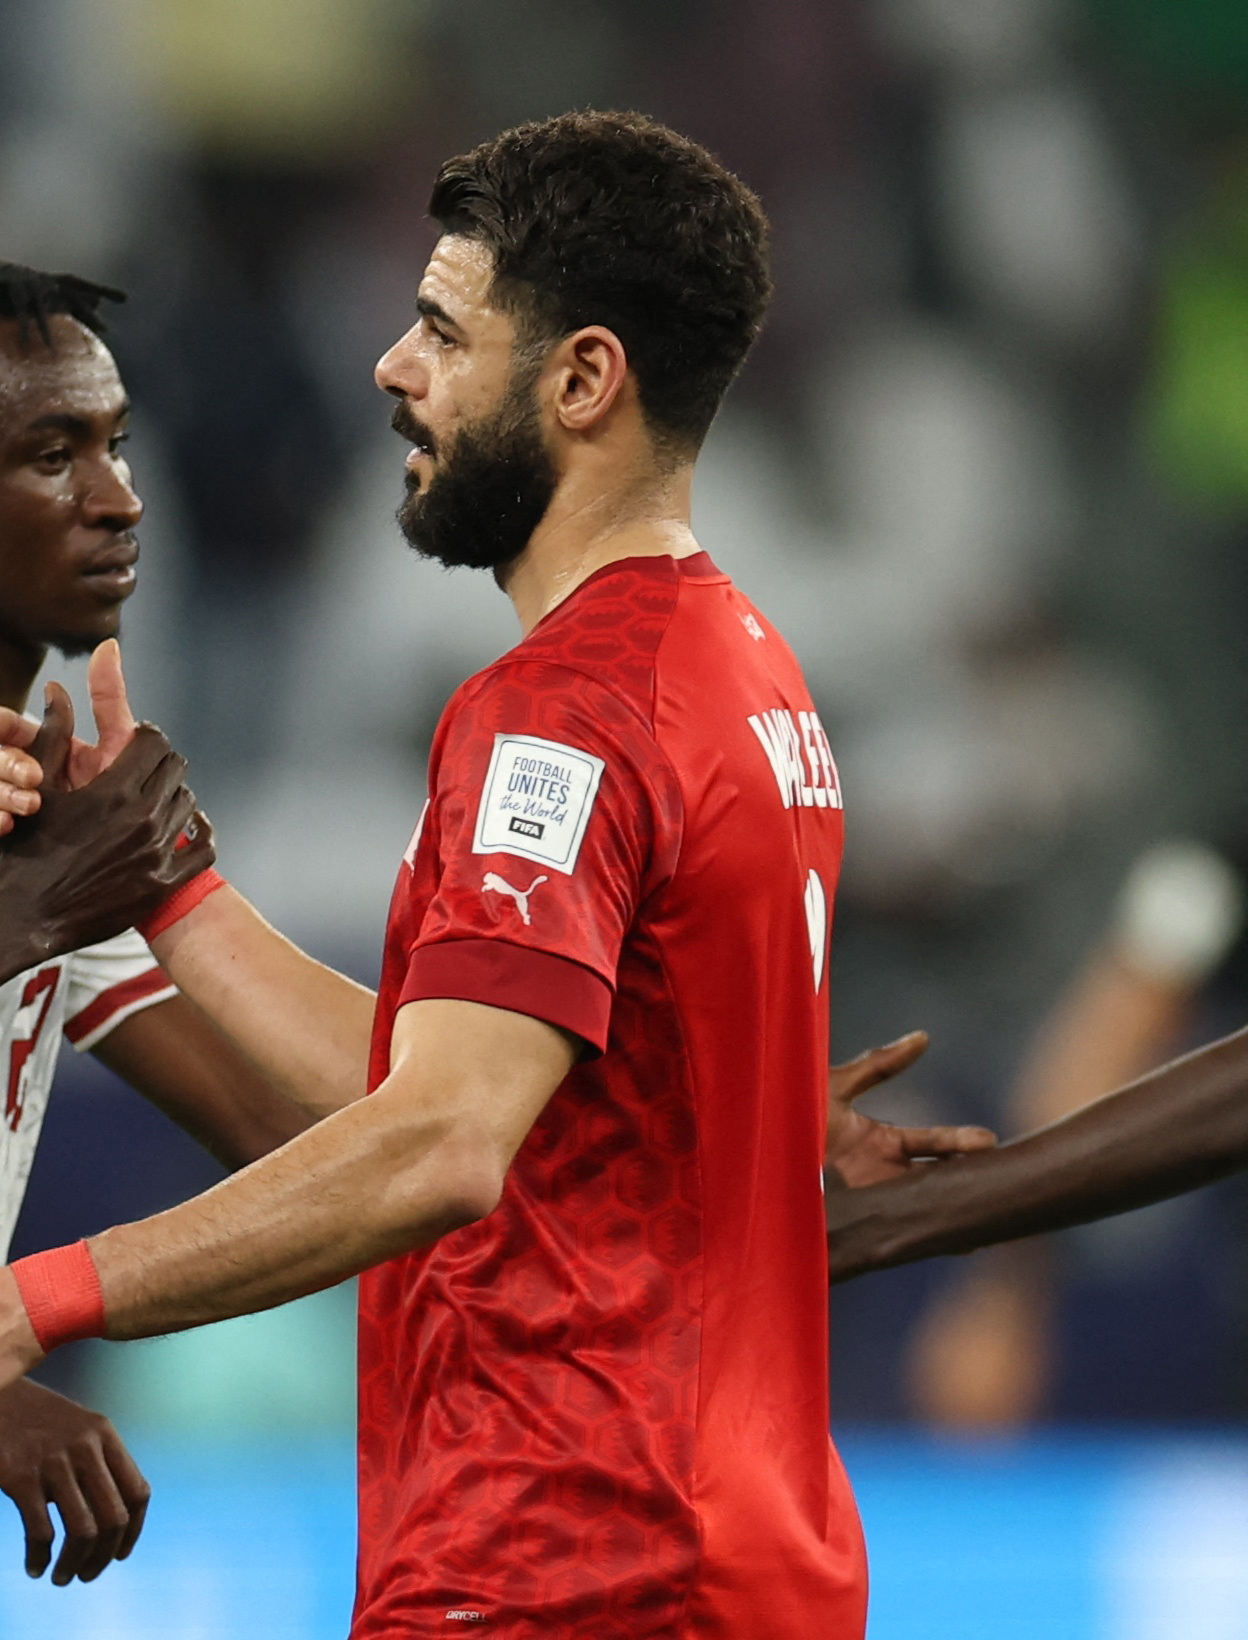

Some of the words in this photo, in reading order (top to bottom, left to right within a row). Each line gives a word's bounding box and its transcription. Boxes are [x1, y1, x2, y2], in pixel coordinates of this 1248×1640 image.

[512, 756, 572, 784] FOOTBALL
[746, 708, 843, 810] WALEE
[507, 772, 570, 805] UNITES
[499, 794, 521, 811] the
[522, 798, 568, 827] World
[511, 821, 541, 837] FIFA
